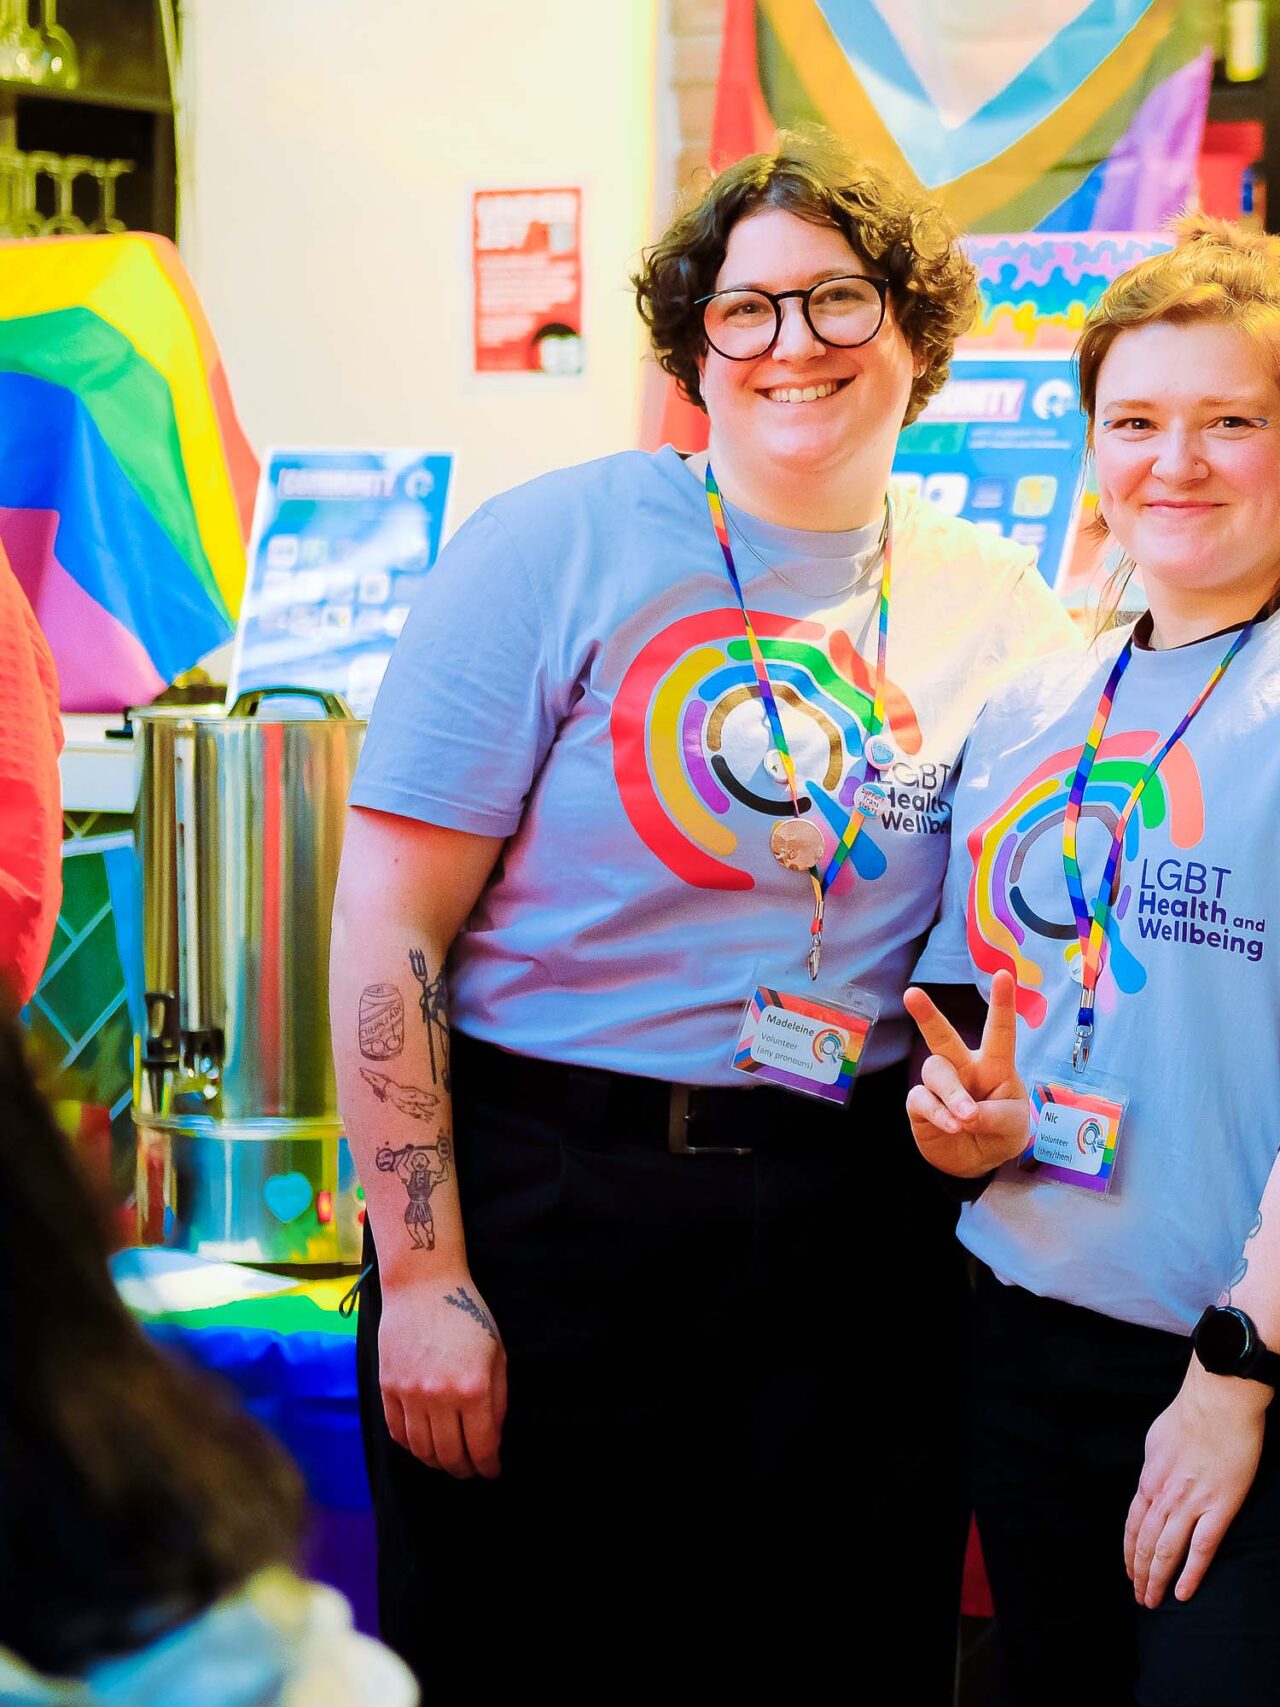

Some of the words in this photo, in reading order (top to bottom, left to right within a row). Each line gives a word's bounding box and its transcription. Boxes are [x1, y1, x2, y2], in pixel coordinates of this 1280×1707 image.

[1140, 858, 1232, 899] LGBT
[1138, 891, 1227, 925] Health
[1233, 917, 1265, 933] and
[1138, 917, 1264, 962] Wellbeing
[766, 1014, 815, 1037] Madeleine
[761, 1032, 798, 1050] Volunteer
[757, 1046, 774, 1057] (any
[775, 1052, 814, 1071] pronouns)
[1045, 1111, 1058, 1124] Nic
[1040, 1133, 1069, 1147] Volunteer
[1037, 1146, 1073, 1163] (they/them)
